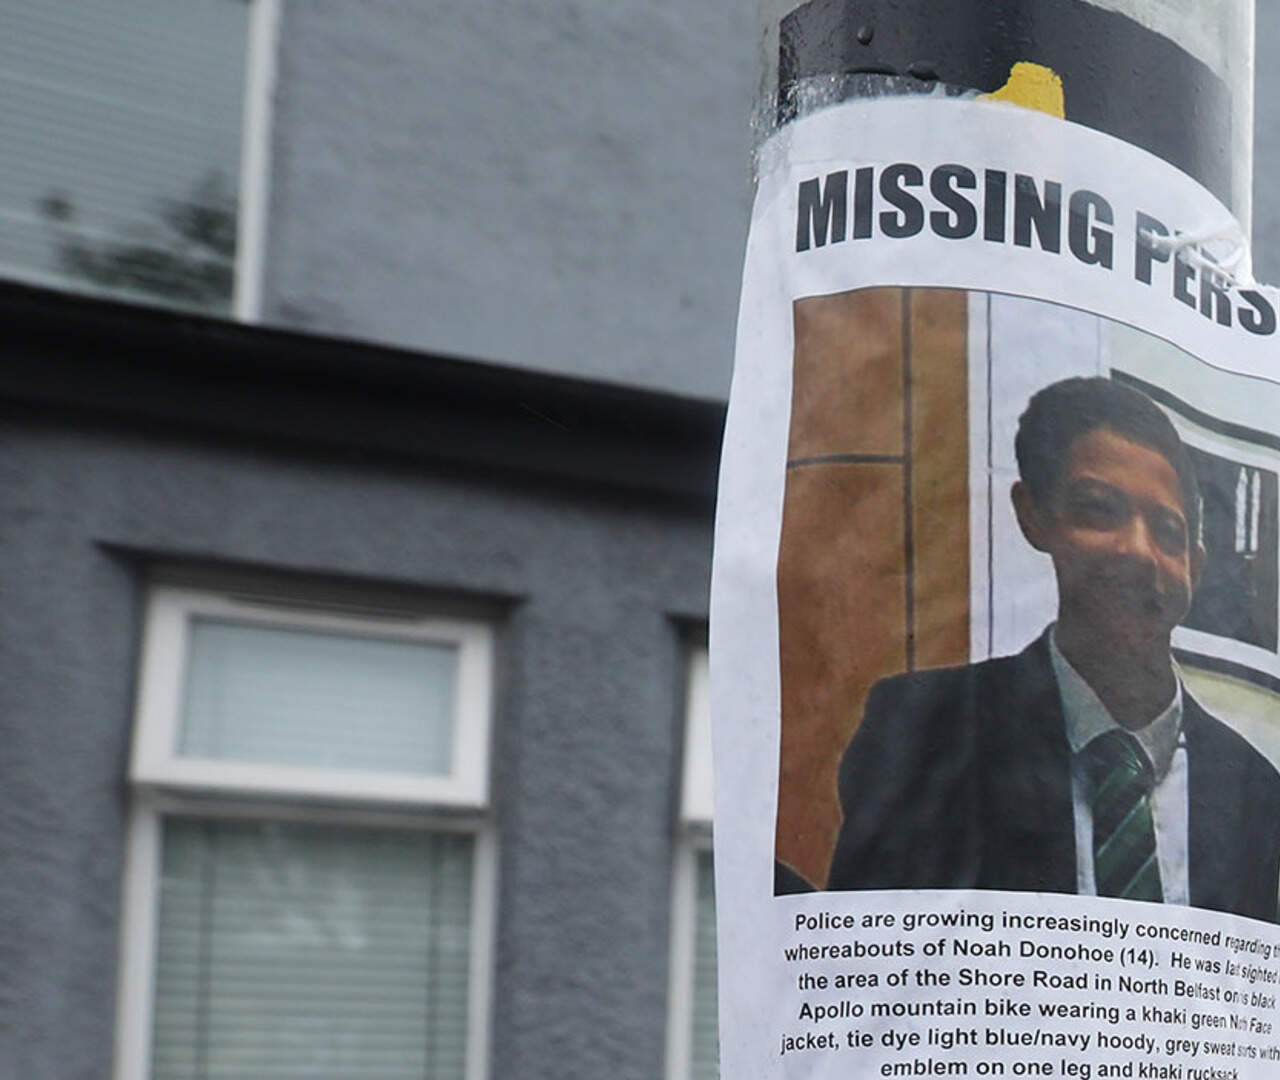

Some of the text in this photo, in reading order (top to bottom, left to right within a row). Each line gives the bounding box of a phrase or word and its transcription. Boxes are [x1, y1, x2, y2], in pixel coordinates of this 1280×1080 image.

[796, 163, 1114, 271] MISSING
[795, 912, 855, 931] Police
[861, 914, 896, 928] are
[902, 910, 994, 932] growing
[1002, 911, 1129, 939] increasingly
[1136, 924, 1221, 946] concerned
[784, 940, 915, 961] whereabouts
[922, 938, 946, 956] of
[953, 939, 1011, 957] Noah
[1020, 941, 1114, 962] Donohoe
[1120, 948, 1159, 970] (14).
[1171, 952, 1191, 970] He
[1195, 958, 1221, 974] was
[799, 973, 828, 990] the
[835, 973, 879, 989] area
[887, 968, 909, 987] of
[916, 969, 951, 987] the
[958, 968, 1025, 987] Shore
[1033, 970, 1088, 990] Road
[1095, 974, 1112, 991] in
[1119, 976, 1168, 995] North
[1174, 980, 1220, 1001] Belfast
[799, 1001, 864, 1023] Apollo
[871, 998, 976, 1017] mountain
[985, 999, 1031, 1016] bike
[1038, 1002, 1120, 1024] wearing
[1126, 1008, 1136, 1021] a
[1142, 1006, 1186, 1024] khaki
[1191, 1012, 1226, 1030] green
[781, 1032, 840, 1056] jacket,
[847, 1030, 873, 1047] tie
[881, 1029, 921, 1050] dye
[928, 1028, 978, 1049] light
[985, 1028, 1091, 1051] blue/navy
[1097, 1032, 1160, 1055] hoody,
[1165, 1038, 1200, 1057] grey
[1203, 1041, 1236, 1057] sweat
[881, 1058, 968, 1077] emblem
[976, 1061, 1005, 1075] on
[1012, 1061, 1054, 1076] one
[1061, 1059, 1091, 1080] leg
[1097, 1061, 1133, 1078] and
[1139, 1062, 1183, 1080] khaki
